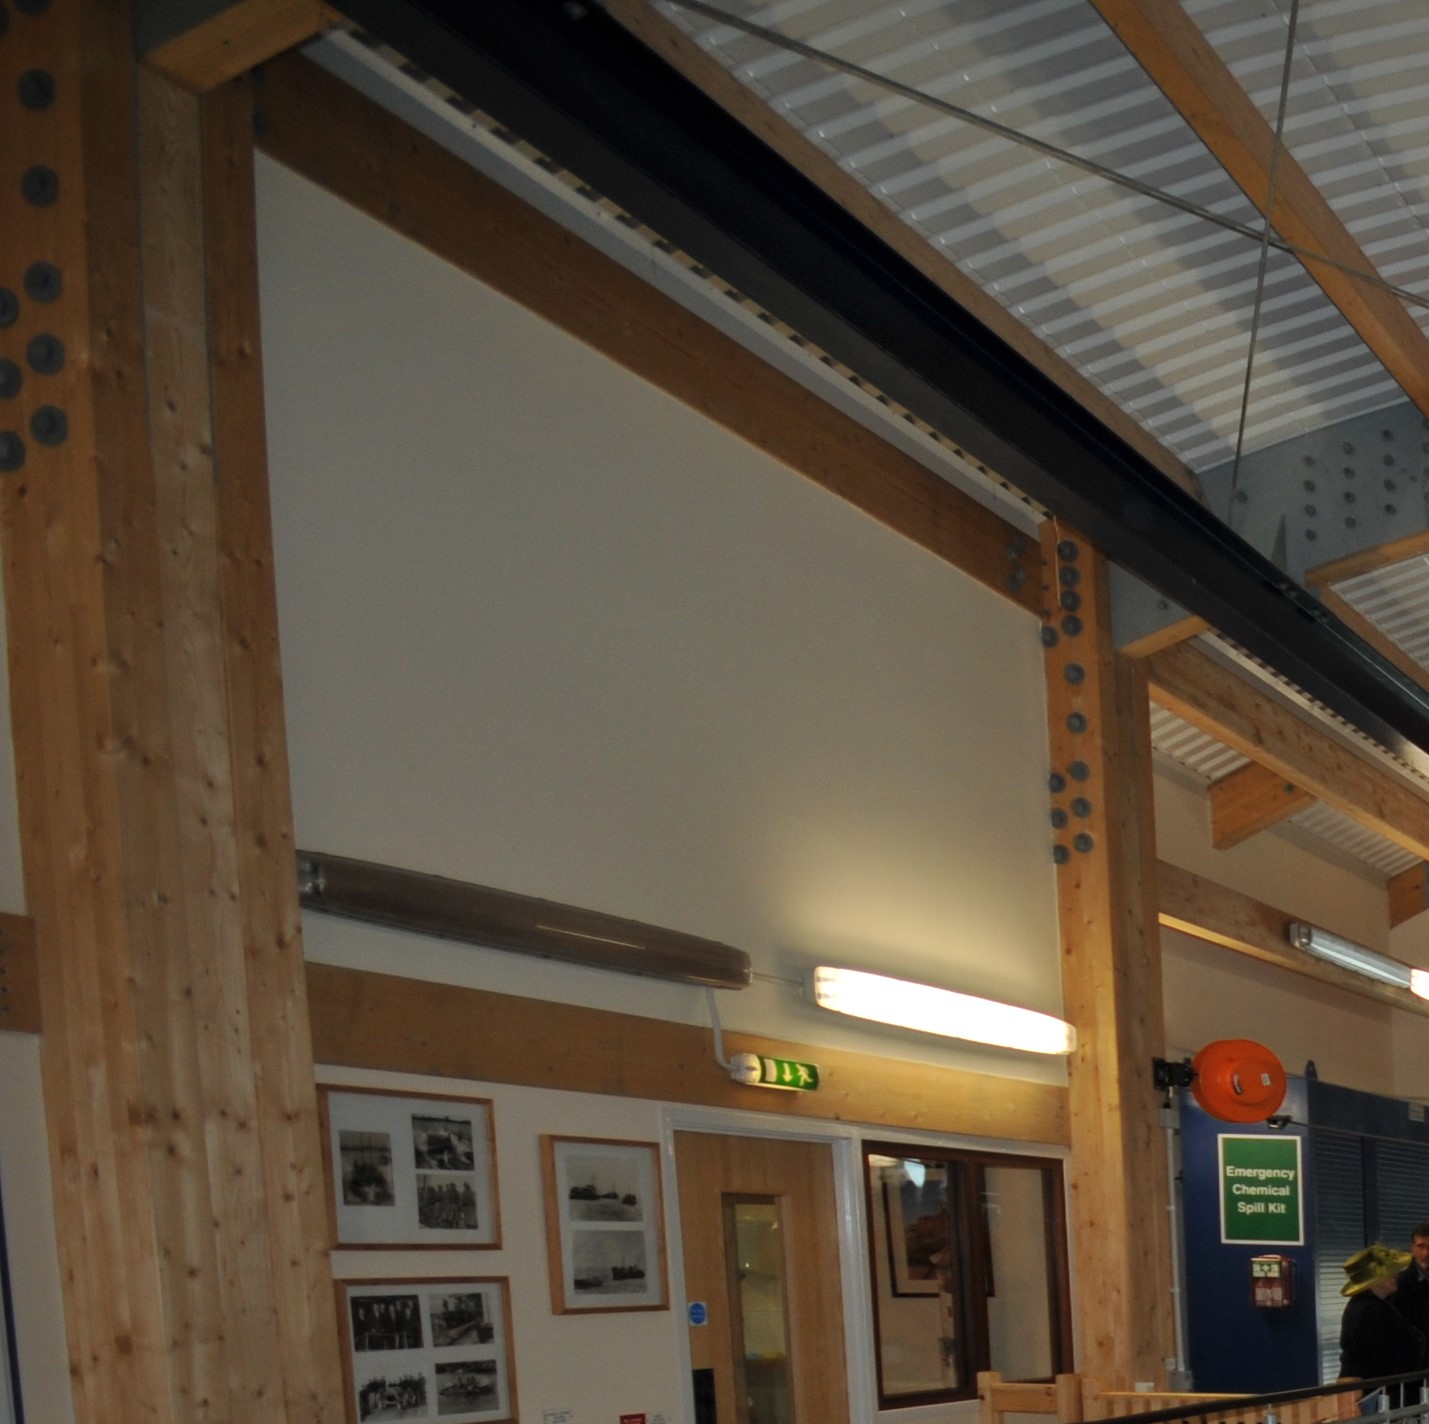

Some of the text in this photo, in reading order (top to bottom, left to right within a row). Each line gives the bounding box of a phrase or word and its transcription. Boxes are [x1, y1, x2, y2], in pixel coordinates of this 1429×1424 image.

[1226, 1165, 1295, 1181] Emergency
[1232, 1183, 1290, 1196] Chemical
[1237, 1201, 1287, 1215] Spill Kit
